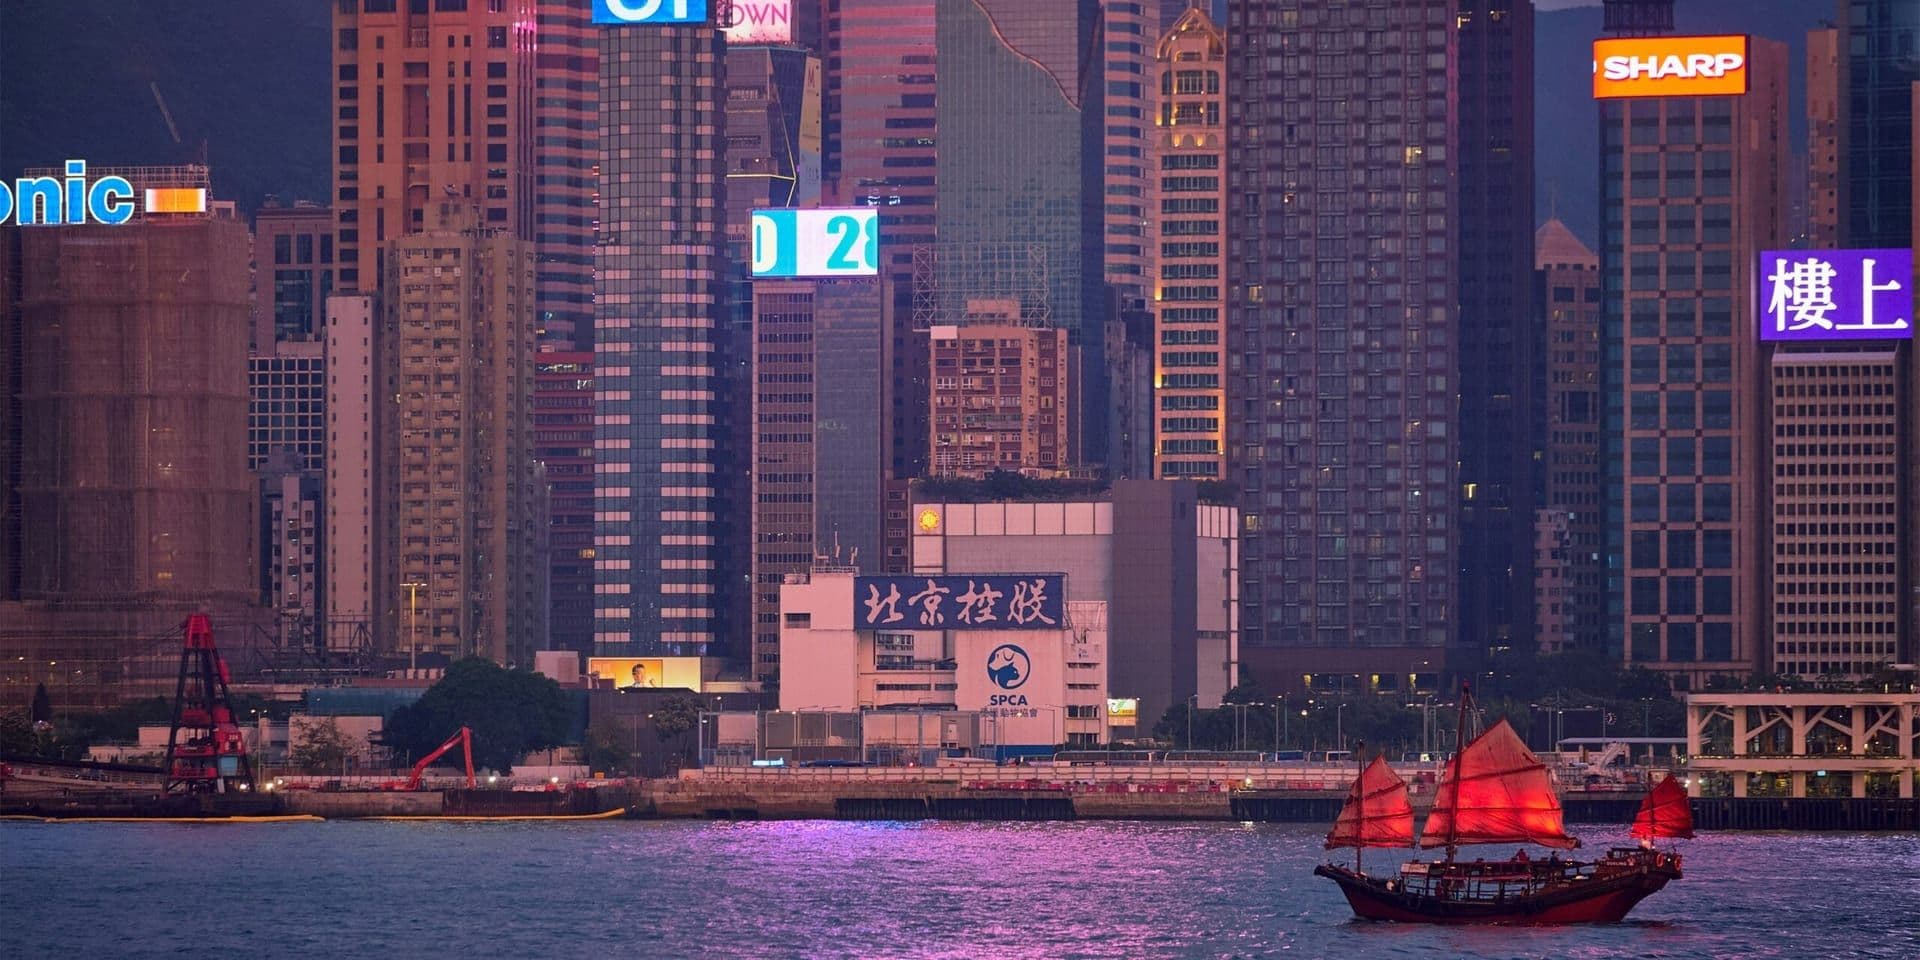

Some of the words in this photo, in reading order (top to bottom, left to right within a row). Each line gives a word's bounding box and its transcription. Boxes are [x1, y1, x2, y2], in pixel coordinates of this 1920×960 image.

[1603, 53, 1744, 80] SHARP
[0, 160, 134, 225] nic
[1768, 257, 1909, 332] 樓上
[864, 579, 1055, 625] 北京控股
[990, 694, 1028, 706] SPCA
